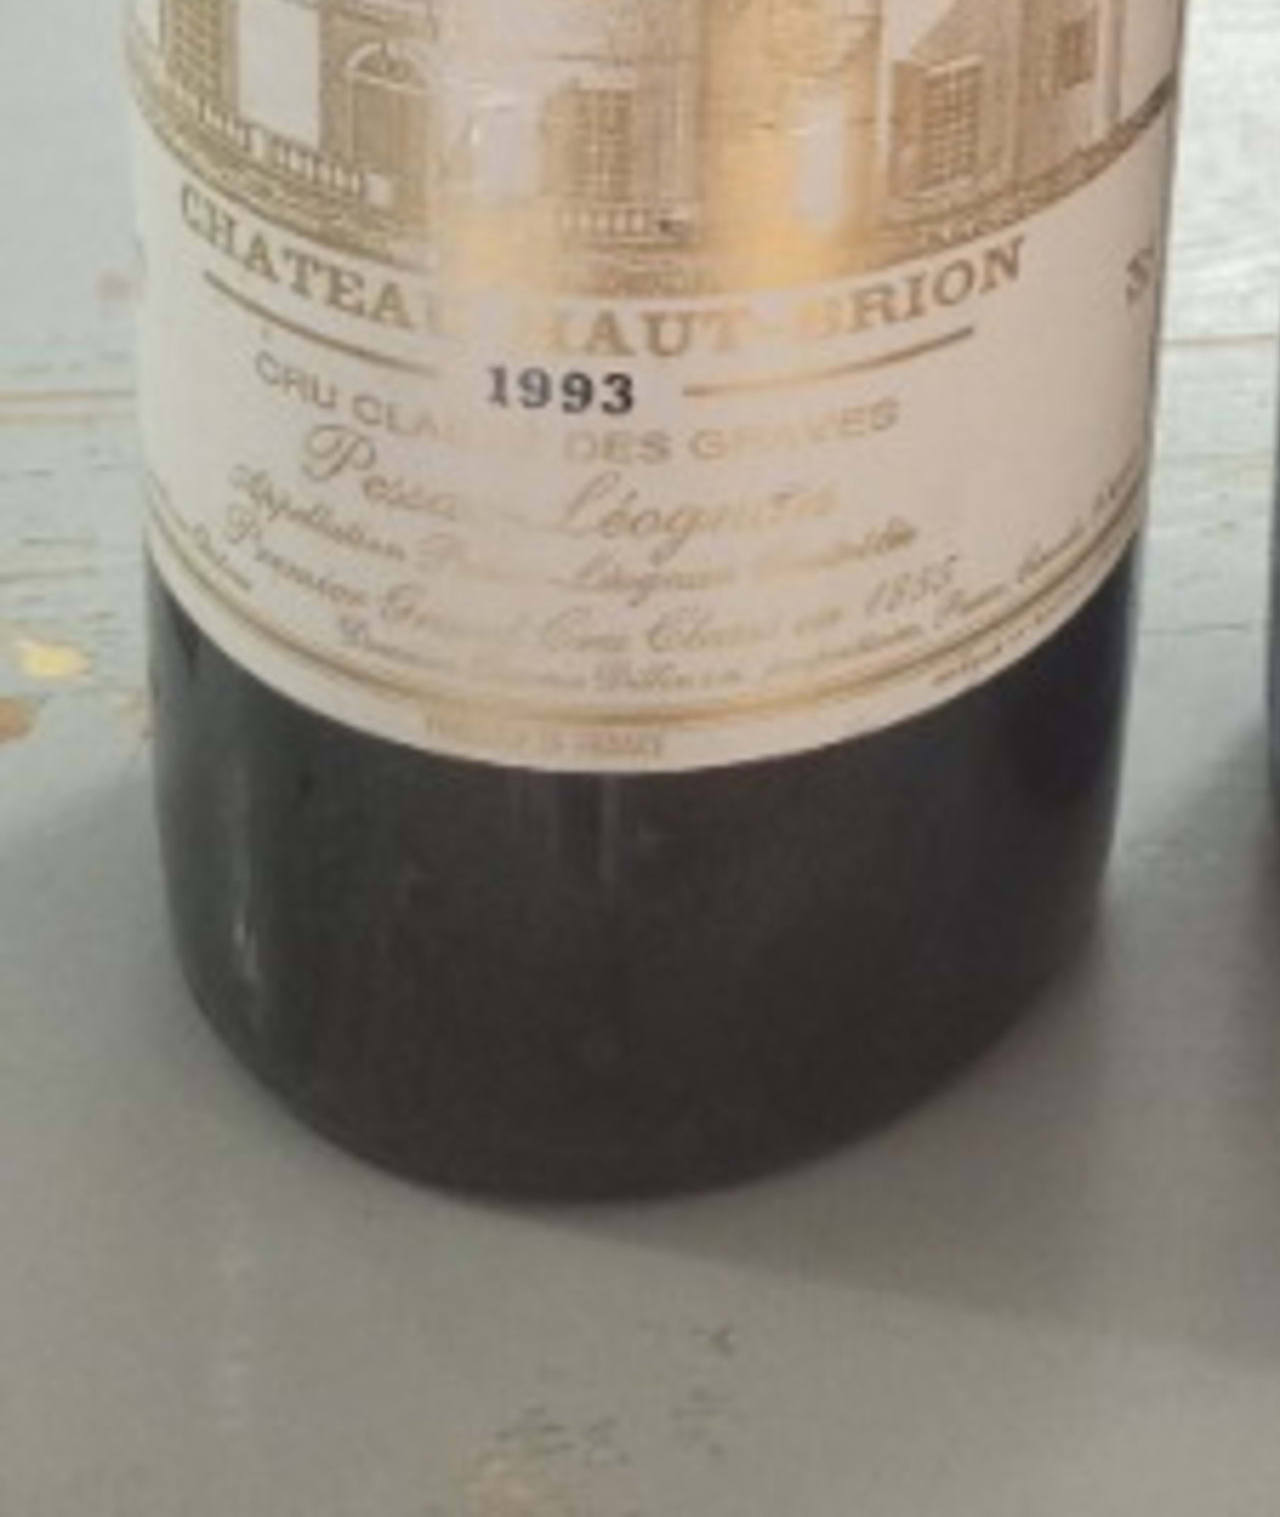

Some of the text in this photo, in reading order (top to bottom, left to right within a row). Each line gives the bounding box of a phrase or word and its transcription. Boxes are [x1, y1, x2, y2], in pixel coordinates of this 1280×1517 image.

[255, 349, 340, 412] CRU
[564, 429, 672, 464] DES
[486, 365, 638, 415] 1993
